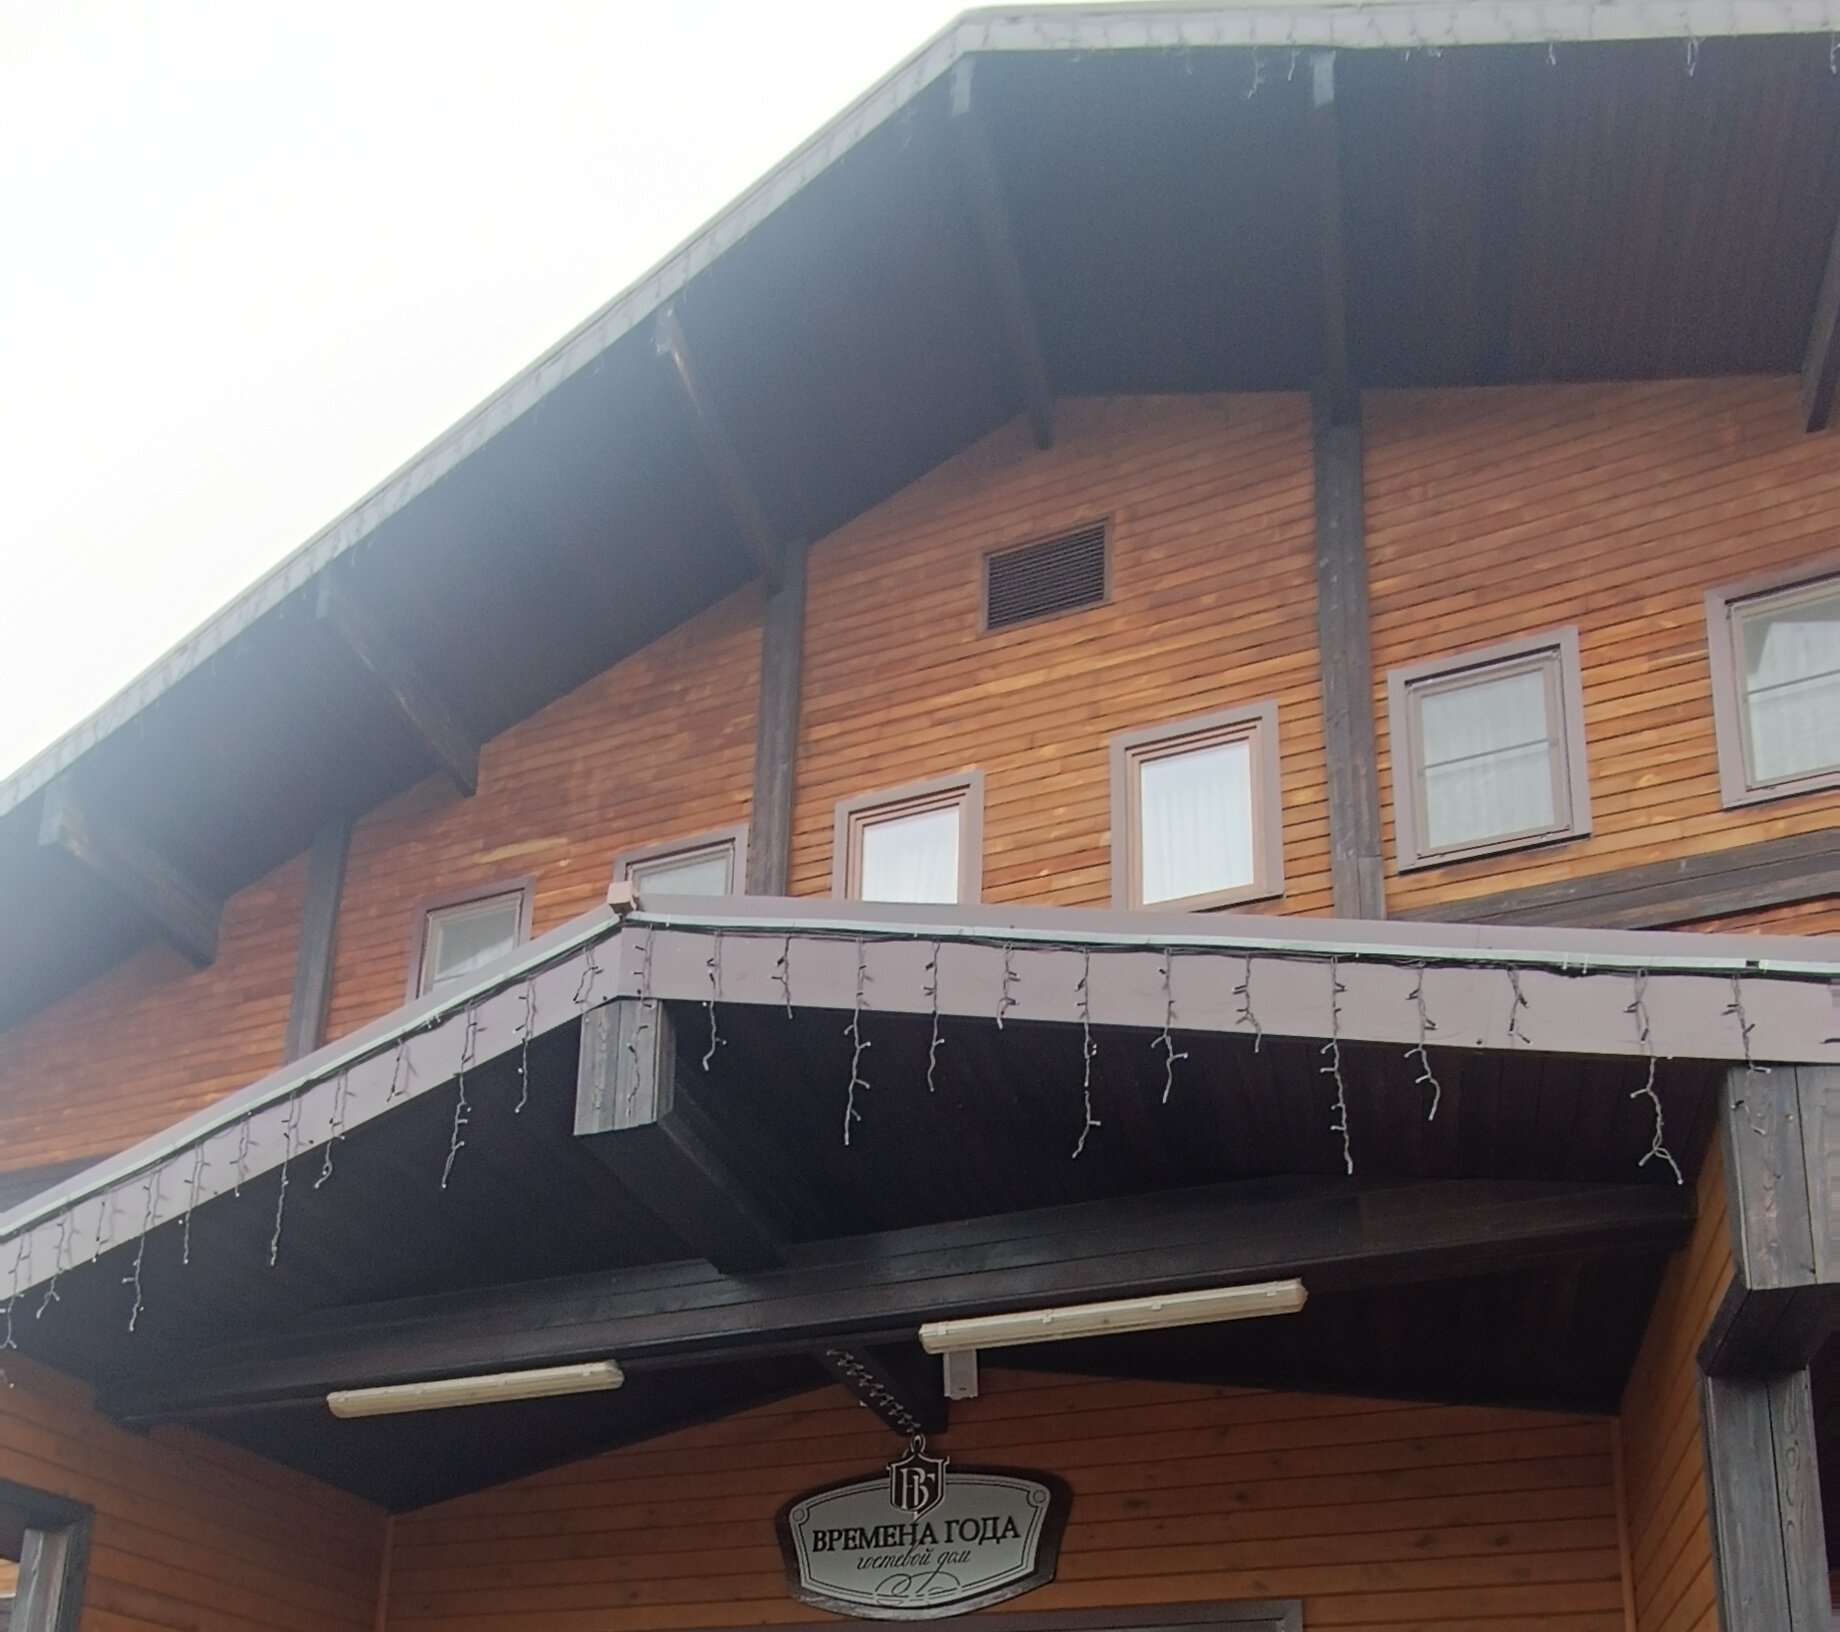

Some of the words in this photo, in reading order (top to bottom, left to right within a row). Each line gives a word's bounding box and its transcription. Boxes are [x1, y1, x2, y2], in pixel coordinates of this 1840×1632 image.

[812, 1521, 938, 1552] ВРЕМЕНА
[944, 1516, 1021, 1546] ГОДА
[857, 1548, 931, 1570] гостевой
[937, 1549, 971, 1572] дом
